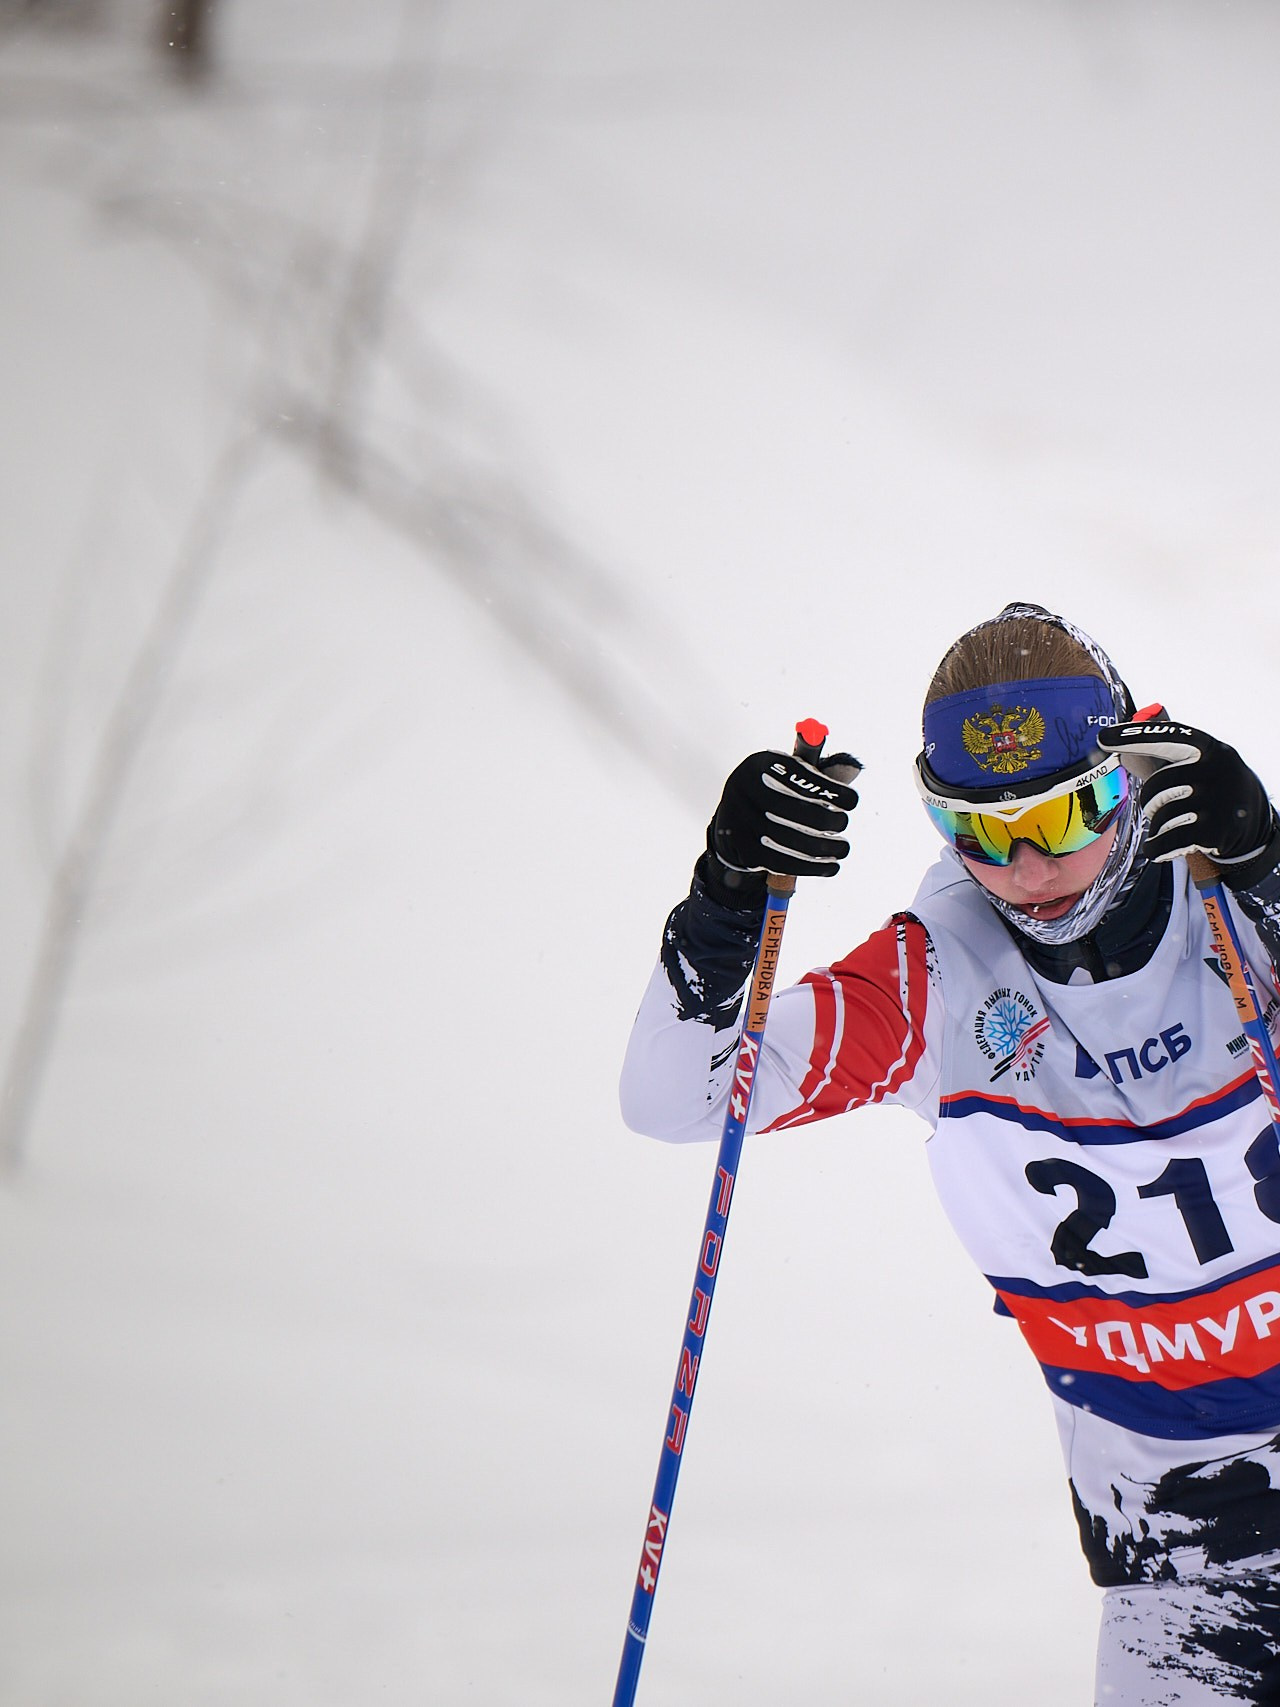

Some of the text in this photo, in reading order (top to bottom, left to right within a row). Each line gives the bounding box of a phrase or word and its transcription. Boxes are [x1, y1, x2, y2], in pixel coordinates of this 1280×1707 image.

[974, 987, 1038, 1060] ФЕДЕРАЦИЯ ЛЫЖНЫХ ГОНОК
[1104, 1022, 1192, 1085] ПСБ
